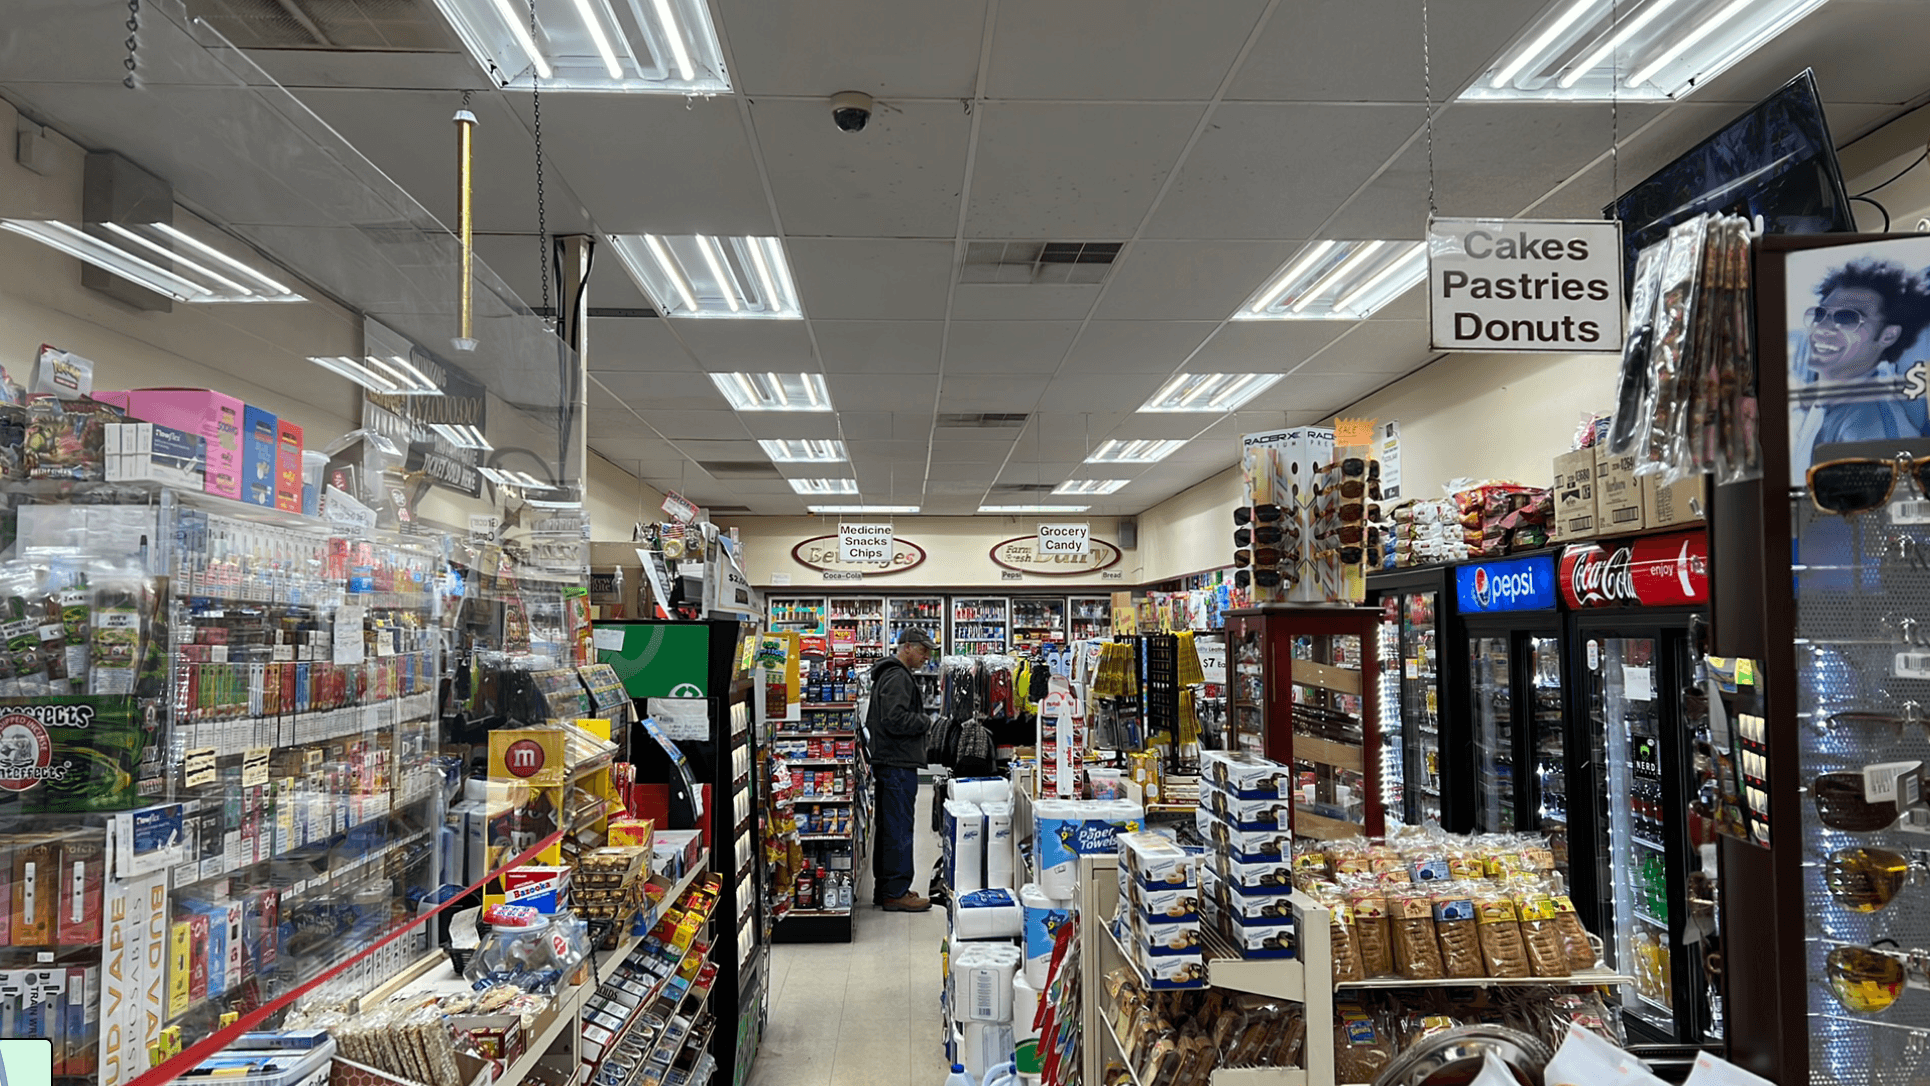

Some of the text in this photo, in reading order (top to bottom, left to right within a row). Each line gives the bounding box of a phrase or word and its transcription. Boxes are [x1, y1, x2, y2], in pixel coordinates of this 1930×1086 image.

[1464, 230, 1589, 260] Cakes
[1443, 270, 1609, 300] Pastries
[1455, 312, 1600, 342] Donuts
[840, 526, 891, 535] Medicine
[1041, 526, 1086, 538] Grocery
[845, 537, 887, 546] Snacks
[1046, 540, 1081, 551] Candy
[849, 548, 883, 559] Chips
[1572, 546, 1637, 605] Coca-Cola
[1650, 562, 1674, 577] enjoy
[1492, 565, 1534, 604] pepsi
[1203, 658, 1216, 668] $7
[514, 749, 535, 767] m
[1636, 760, 1656, 772] NERD
[1061, 832, 1068, 840] 9
[1079, 827, 1115, 841] Paper
[1080, 836, 1118, 850] Towels
[513, 882, 551, 899] Bazooka
[149, 884, 164, 969] BUD
[107, 896, 126, 1018] VAPE
[29, 986, 39, 1038] TRAIN WRE
